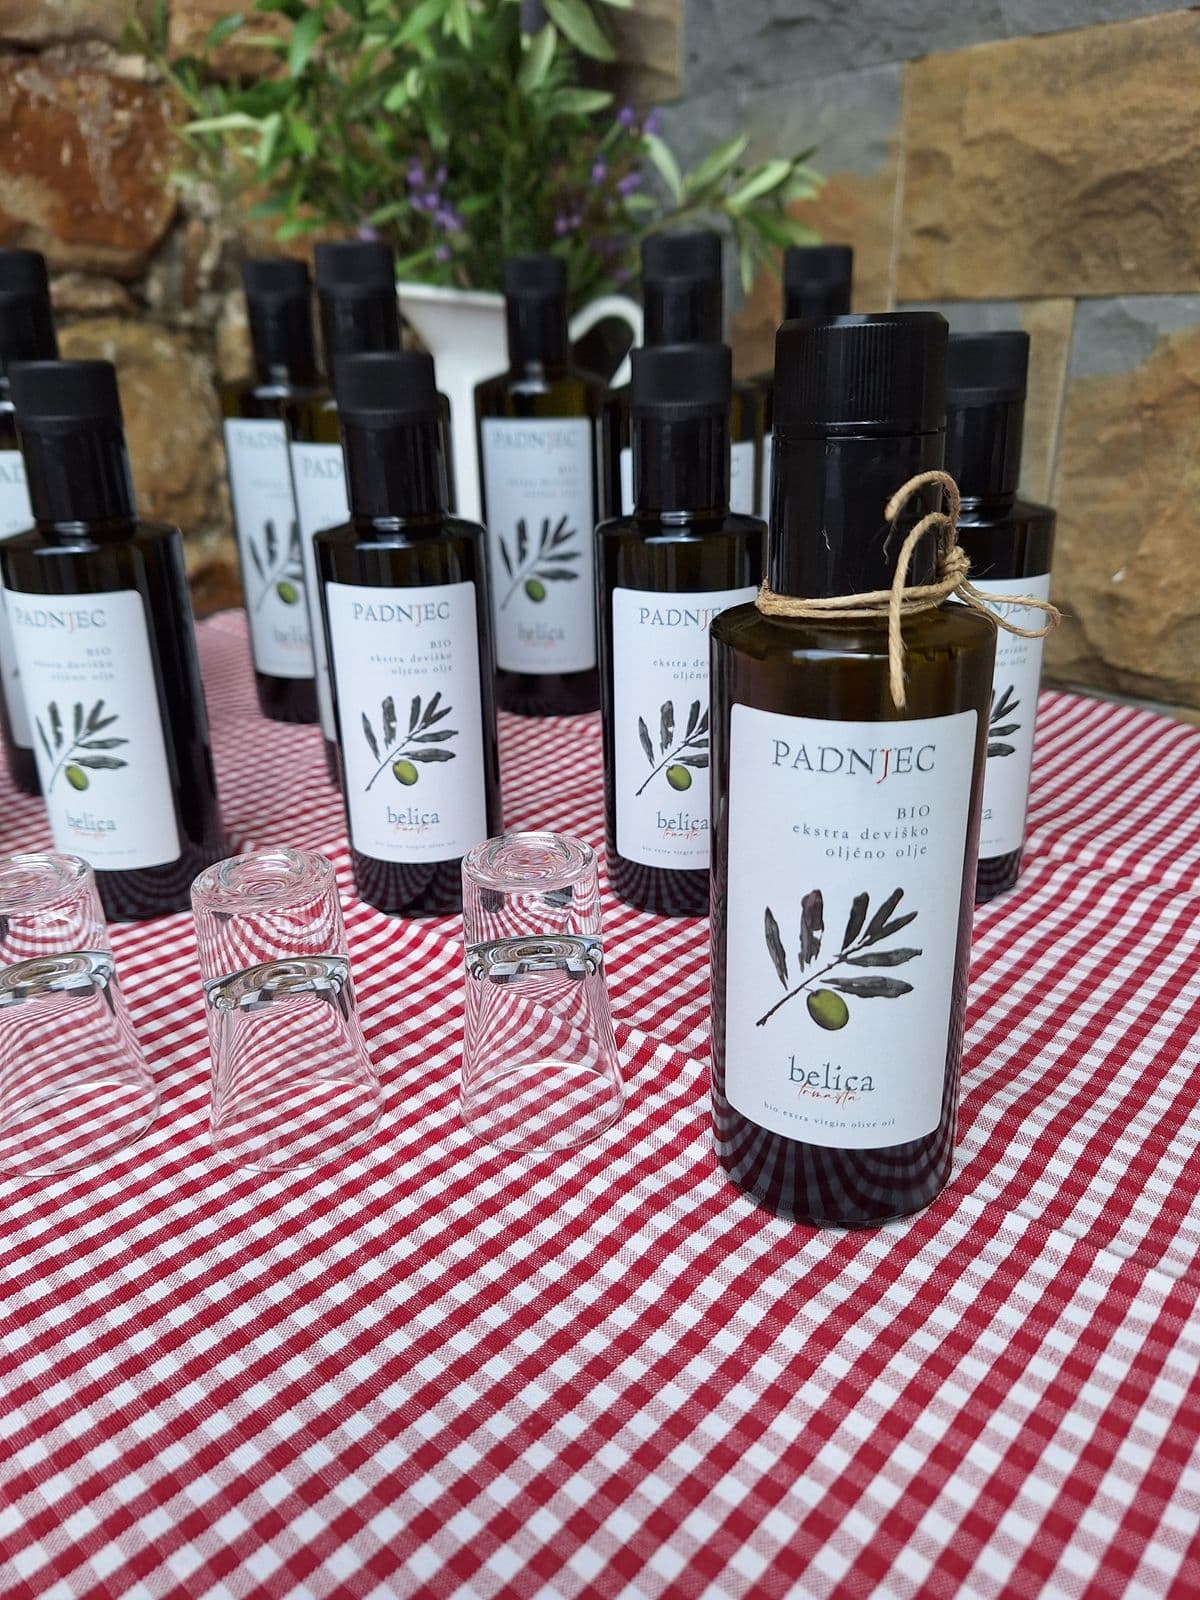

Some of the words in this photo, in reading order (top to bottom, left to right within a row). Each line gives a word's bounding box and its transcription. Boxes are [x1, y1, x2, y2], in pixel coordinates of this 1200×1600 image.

[15, 607, 106, 634] PADNJEC
[352, 602, 450, 627] PADNJEC
[772, 739, 936, 784] PADNJEC
[385, 806, 440, 825] belica
[656, 811, 708, 830] belica
[896, 805, 930, 819] BIO
[792, 824, 849, 840] ekstra
[860, 825, 929, 840] deviško
[895, 844, 928, 860] olje
[788, 1055, 875, 1091] belica
[763, 1101, 778, 1113] bio
[783, 1110, 809, 1122] extra
[814, 1119, 846, 1129] virgin
[850, 1119, 877, 1129] olive
[881, 1117, 895, 1127] oil
